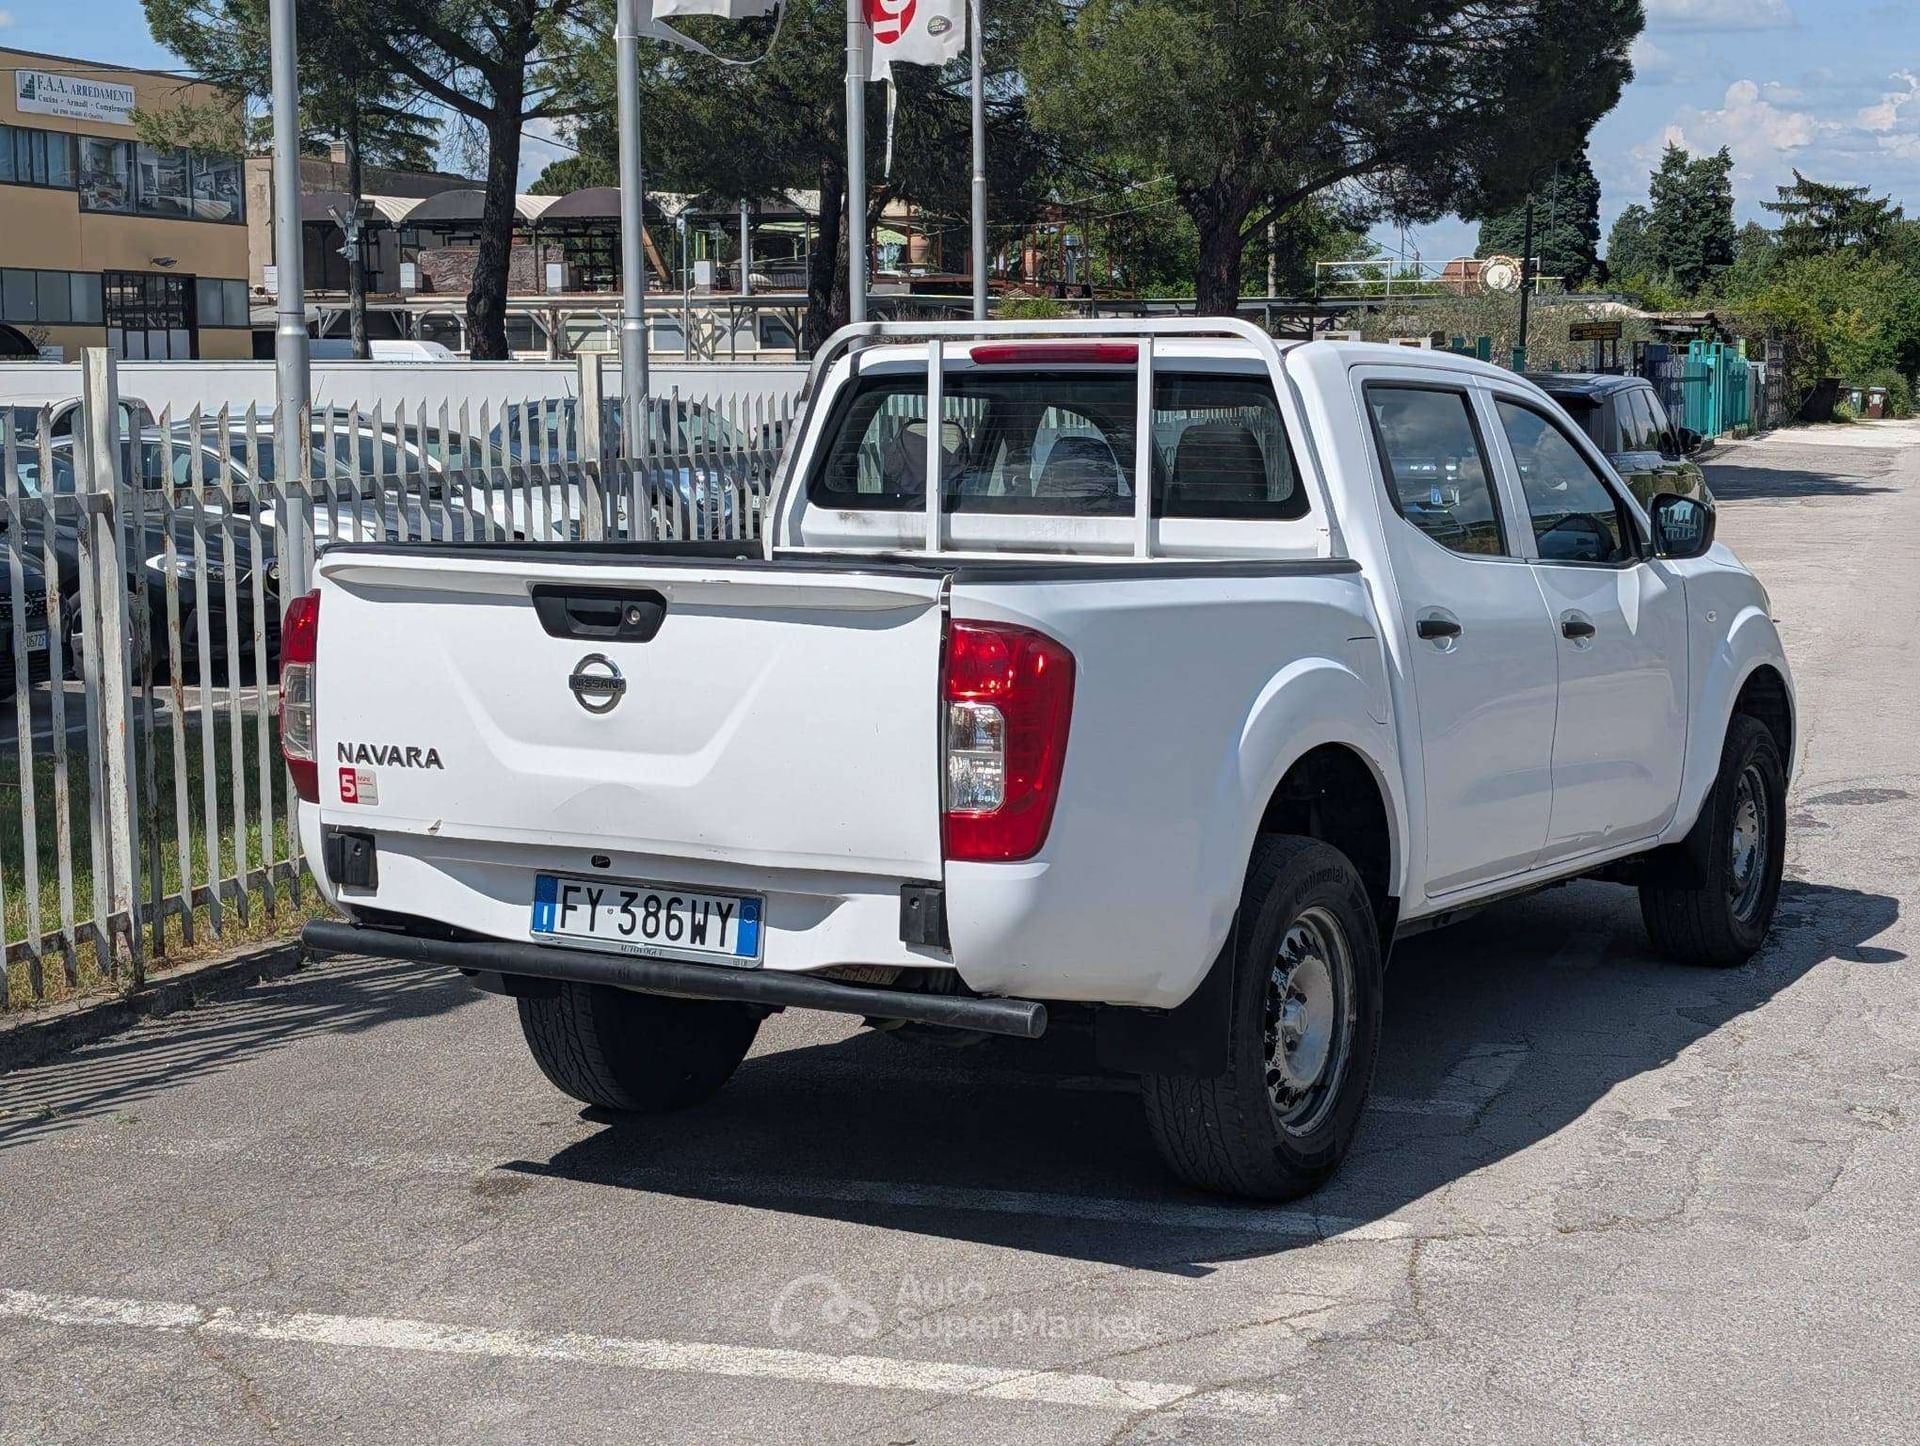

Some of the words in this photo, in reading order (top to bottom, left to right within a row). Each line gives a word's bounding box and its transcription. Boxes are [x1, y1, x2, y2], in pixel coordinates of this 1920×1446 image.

[37, 74, 67, 94] F.A.A.
[70, 84, 133, 103] ARREDAMENTI
[574, 678, 619, 689] NISSAN
[337, 741, 445, 770] NAVARA
[341, 774, 356, 798] 5
